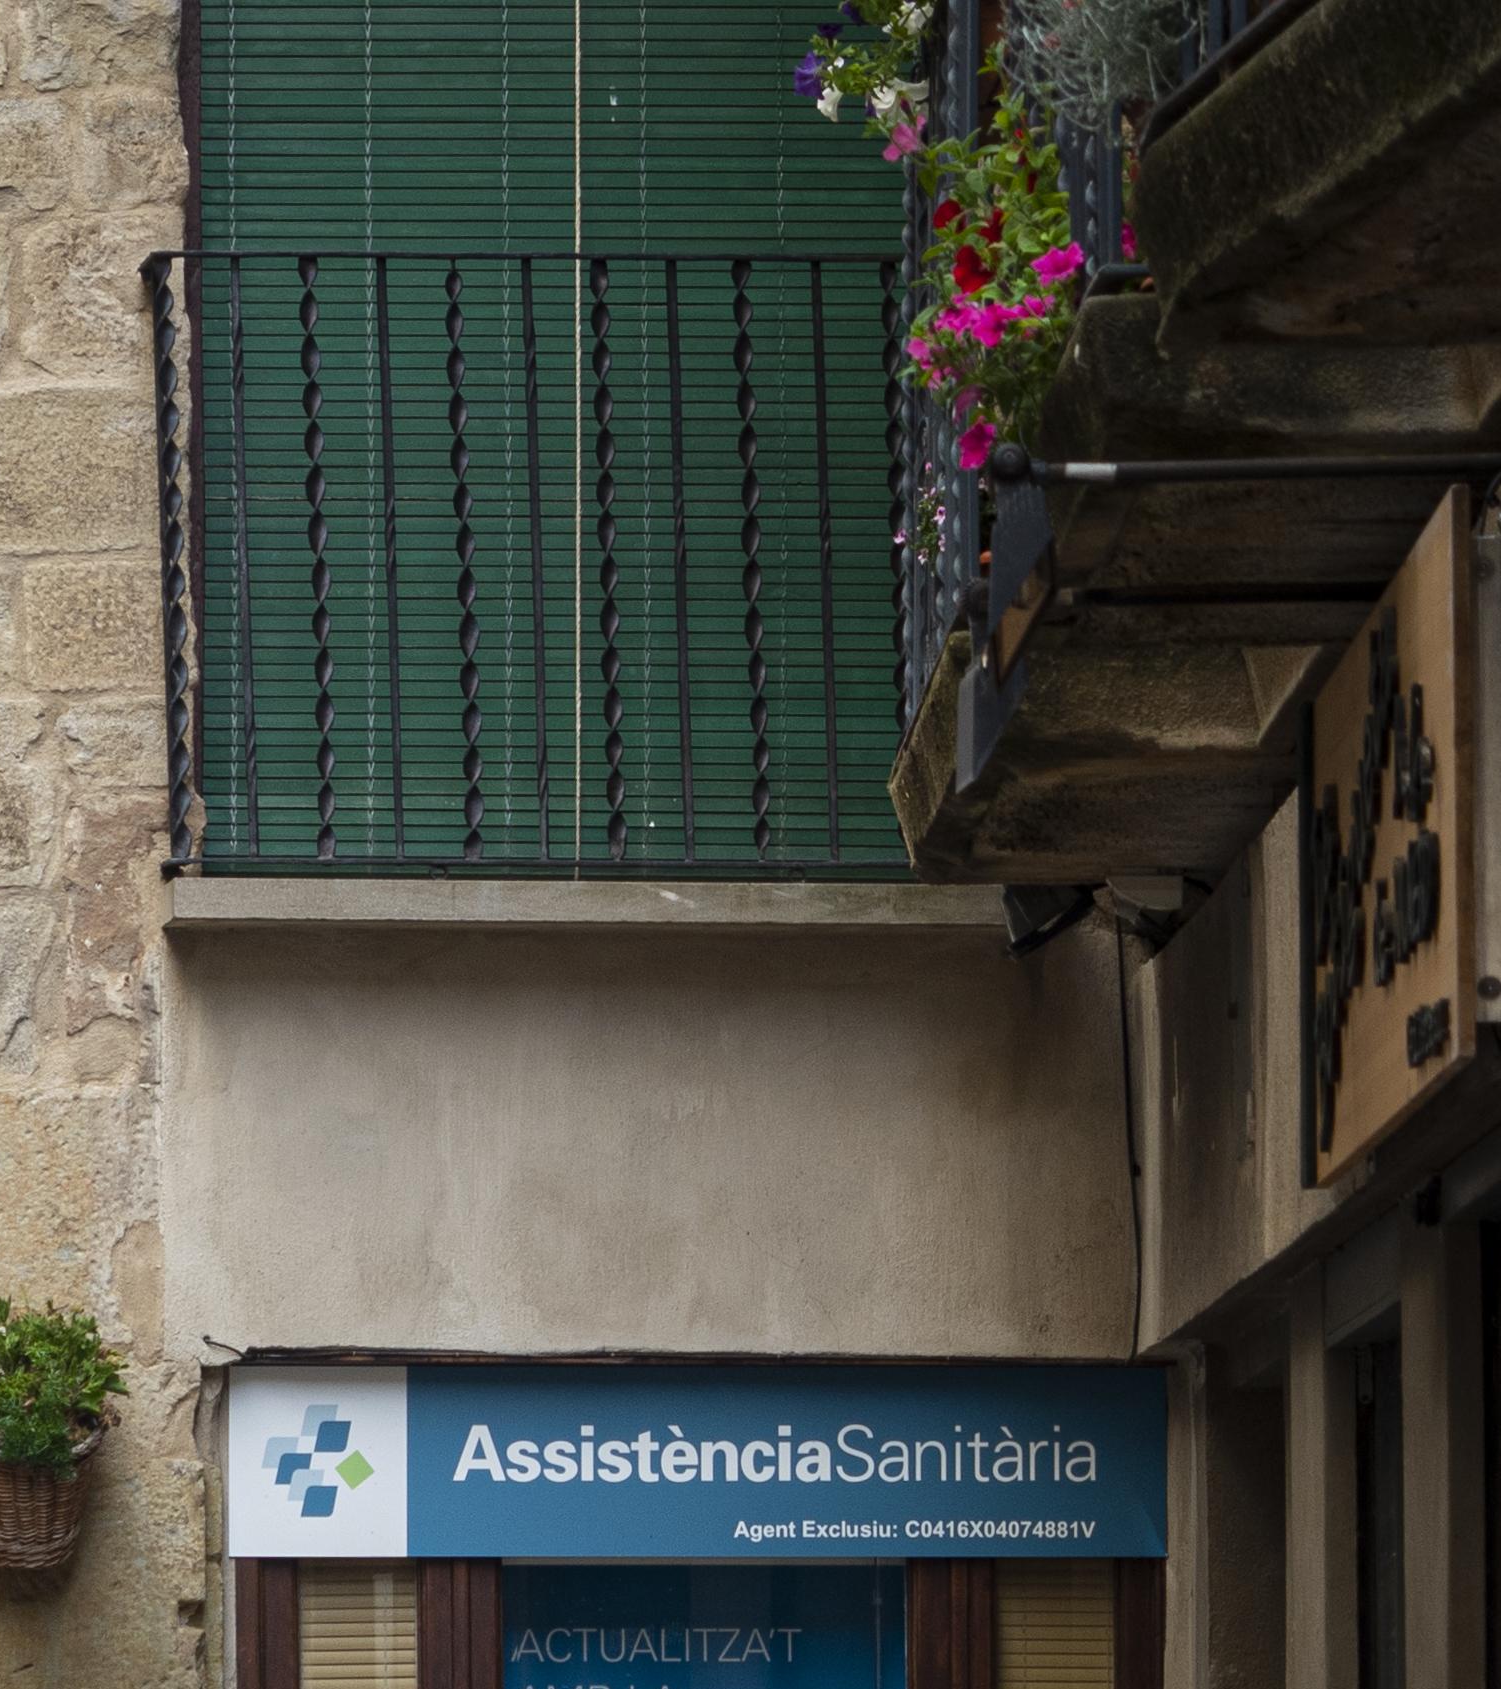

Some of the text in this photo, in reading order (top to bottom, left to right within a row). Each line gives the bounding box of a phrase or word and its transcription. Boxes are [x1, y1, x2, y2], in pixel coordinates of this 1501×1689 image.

[733, 1519, 1095, 1540] Agent Exclusiu: C0416X04074881V
[514, 1628, 803, 1663] ACTUALITZA'T
